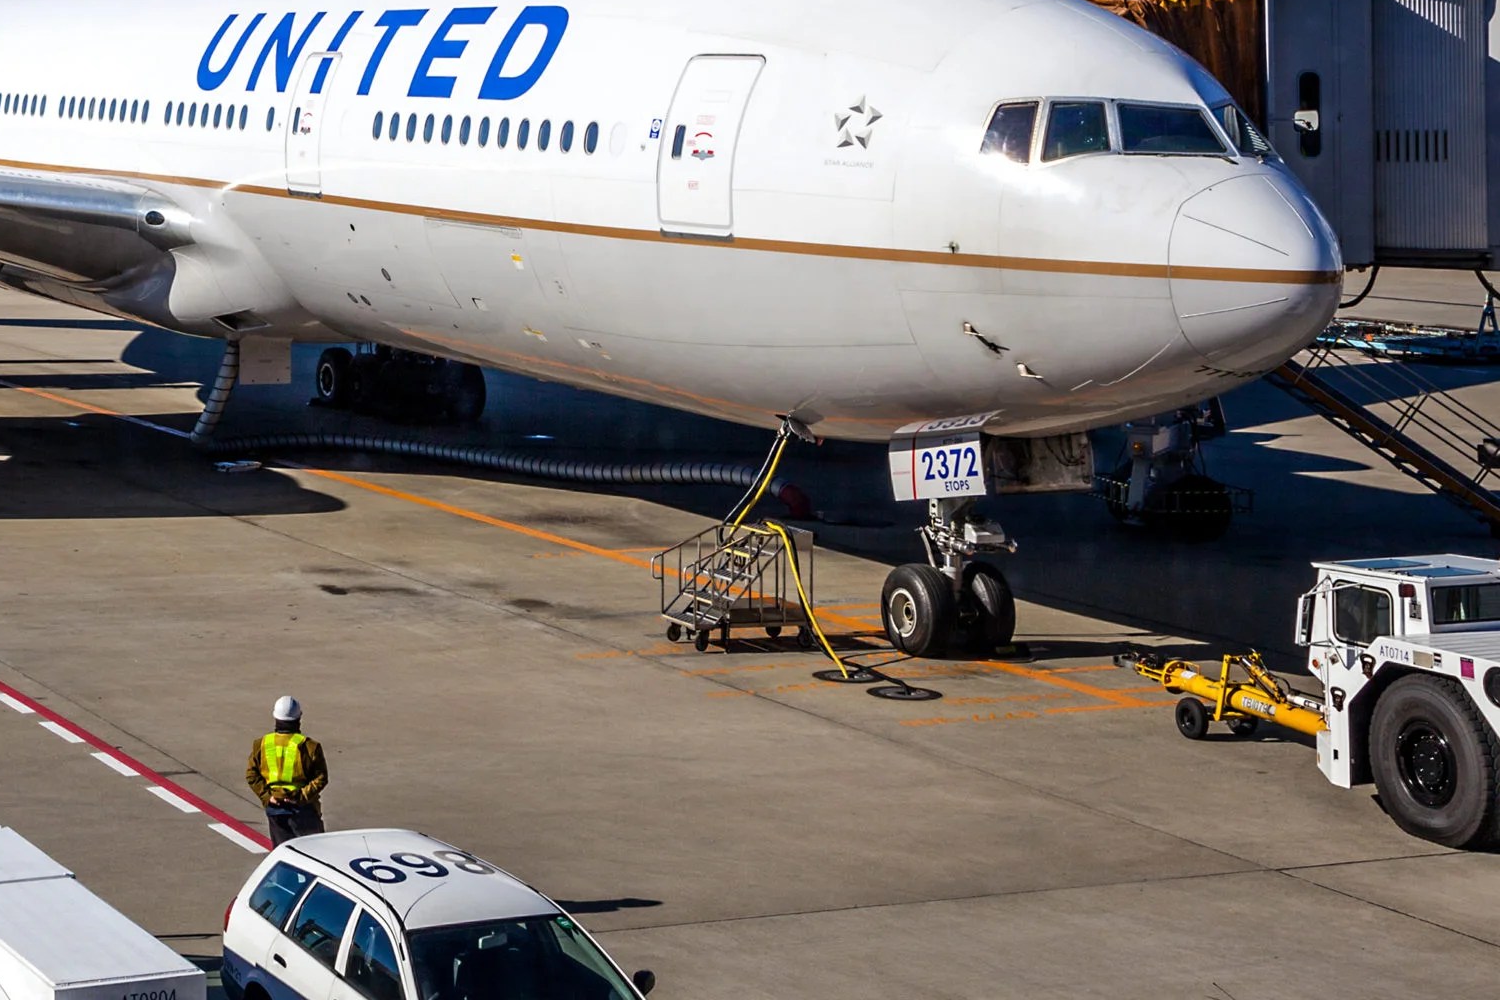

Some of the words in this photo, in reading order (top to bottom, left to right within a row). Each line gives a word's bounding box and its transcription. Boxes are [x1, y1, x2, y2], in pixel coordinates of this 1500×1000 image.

[197, 5, 569, 100] UNITED
[921, 447, 979, 480] 2372
[945, 480, 970, 492] ETOPS
[349, 850, 496, 884] 698
